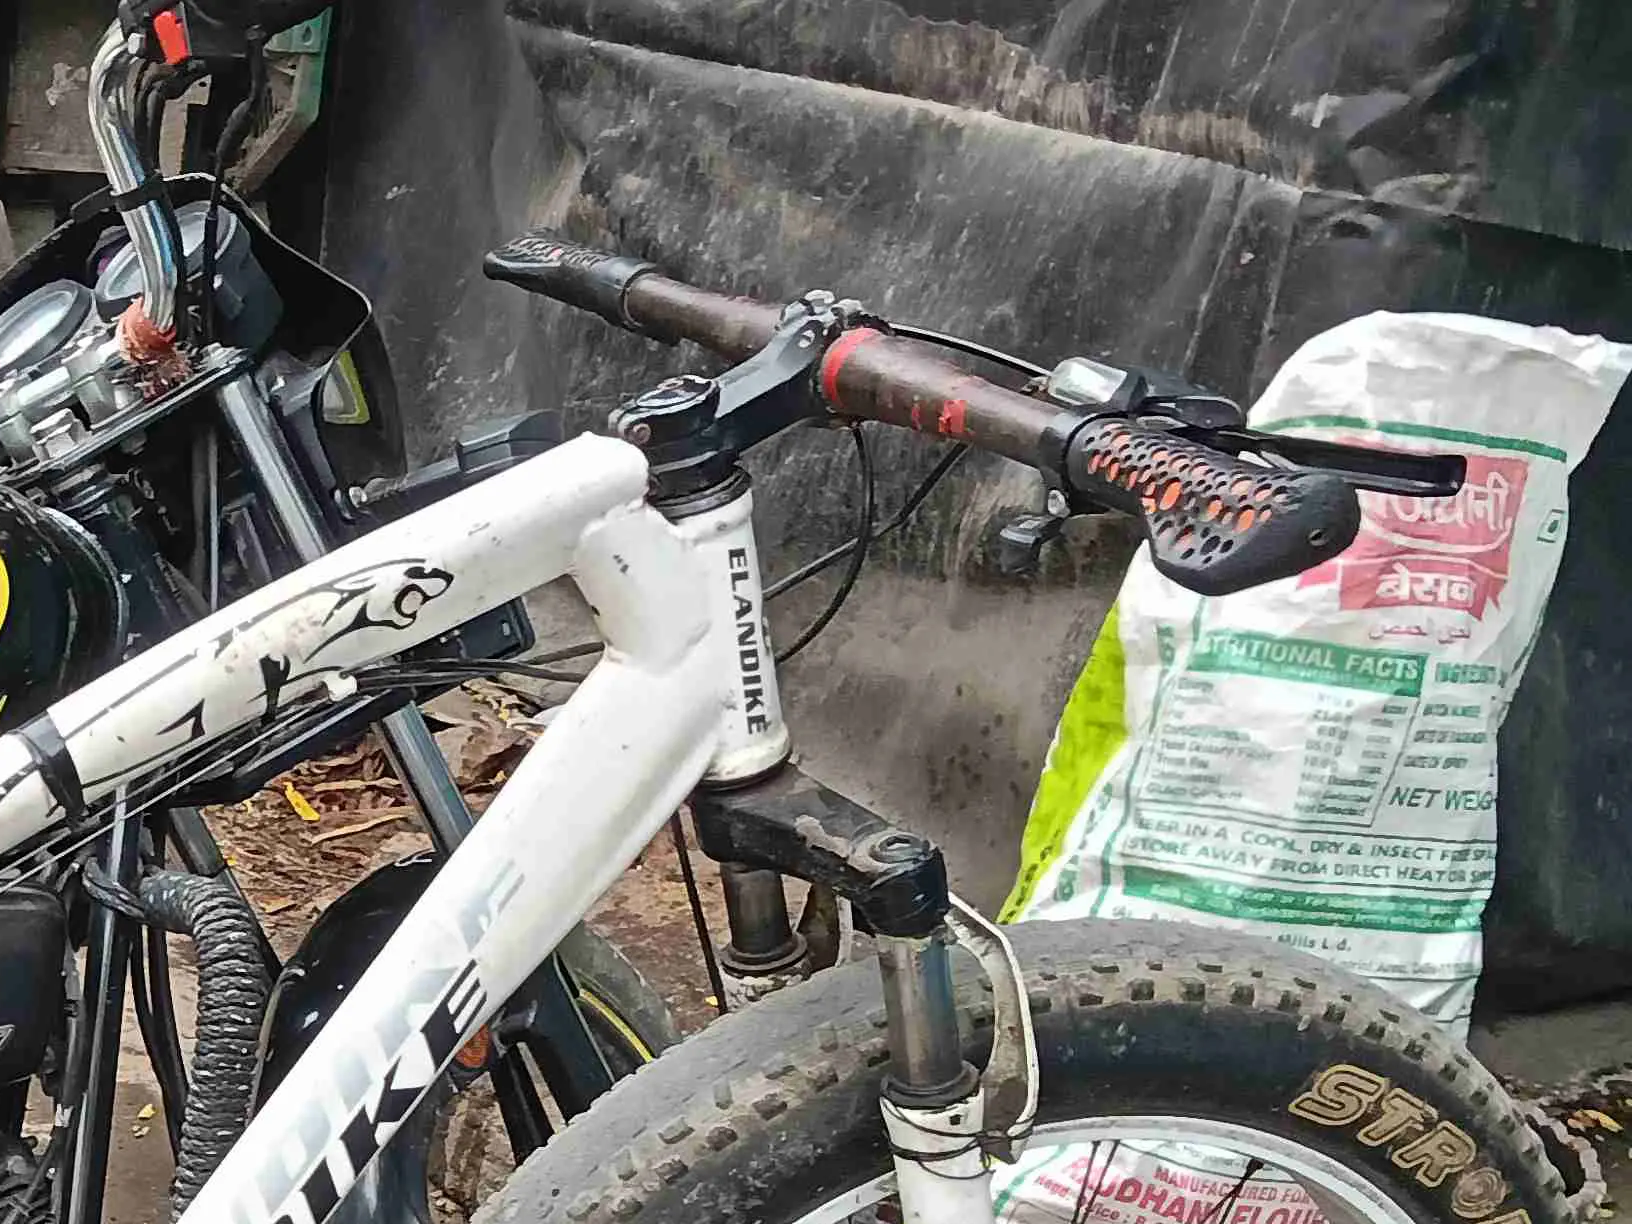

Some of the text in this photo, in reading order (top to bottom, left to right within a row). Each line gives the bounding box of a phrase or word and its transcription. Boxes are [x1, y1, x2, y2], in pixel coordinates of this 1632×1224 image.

[729, 547, 768, 735] ELANDIKE
[1344, 652, 1420, 680] FACTS
[1389, 786, 1441, 809] NET
[1126, 835, 1190, 857] STORE
[1195, 845, 1265, 868] AWAY
[1270, 858, 1328, 876] FROM
[1333, 862, 1392, 880] DIRECT
[1396, 866, 1448, 884] HEAT
[1370, 843, 1435, 862] INSECT
